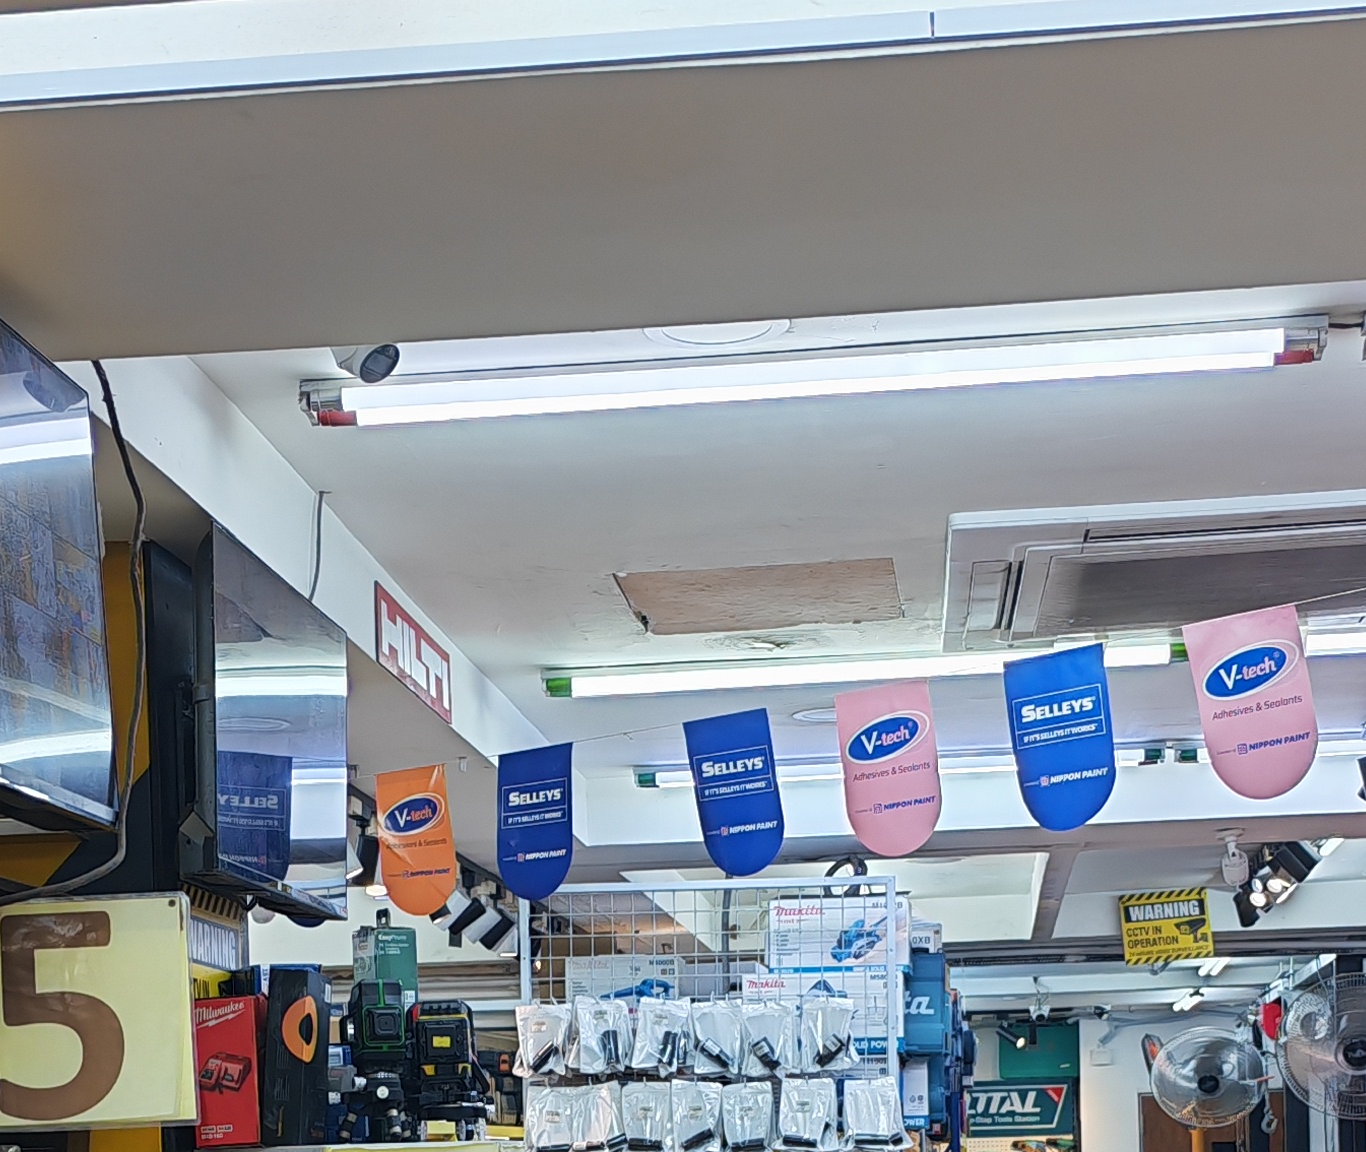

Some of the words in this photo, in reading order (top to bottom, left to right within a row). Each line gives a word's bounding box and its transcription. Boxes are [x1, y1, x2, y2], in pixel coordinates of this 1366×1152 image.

[381, 598, 450, 711] HILTI
[1219, 656, 1277, 691] V-tech
[1021, 697, 1094, 723] SELLEYS
[860, 725, 910, 754] V-tech
[702, 757, 763, 778] SELLEYS
[853, 769, 890, 782] Adhesives
[898, 761, 931, 775] Sealants
[508, 788, 561, 806] SELLEYS
[395, 805, 433, 828] V-tech
[1129, 901, 1200, 921] WARNING
[1126, 926, 1150, 938] CCTV
[1152, 925, 1162, 935] IN
[1128, 936, 1179, 949] OPERATION
[195, 1000, 246, 1023] Milwaukee
